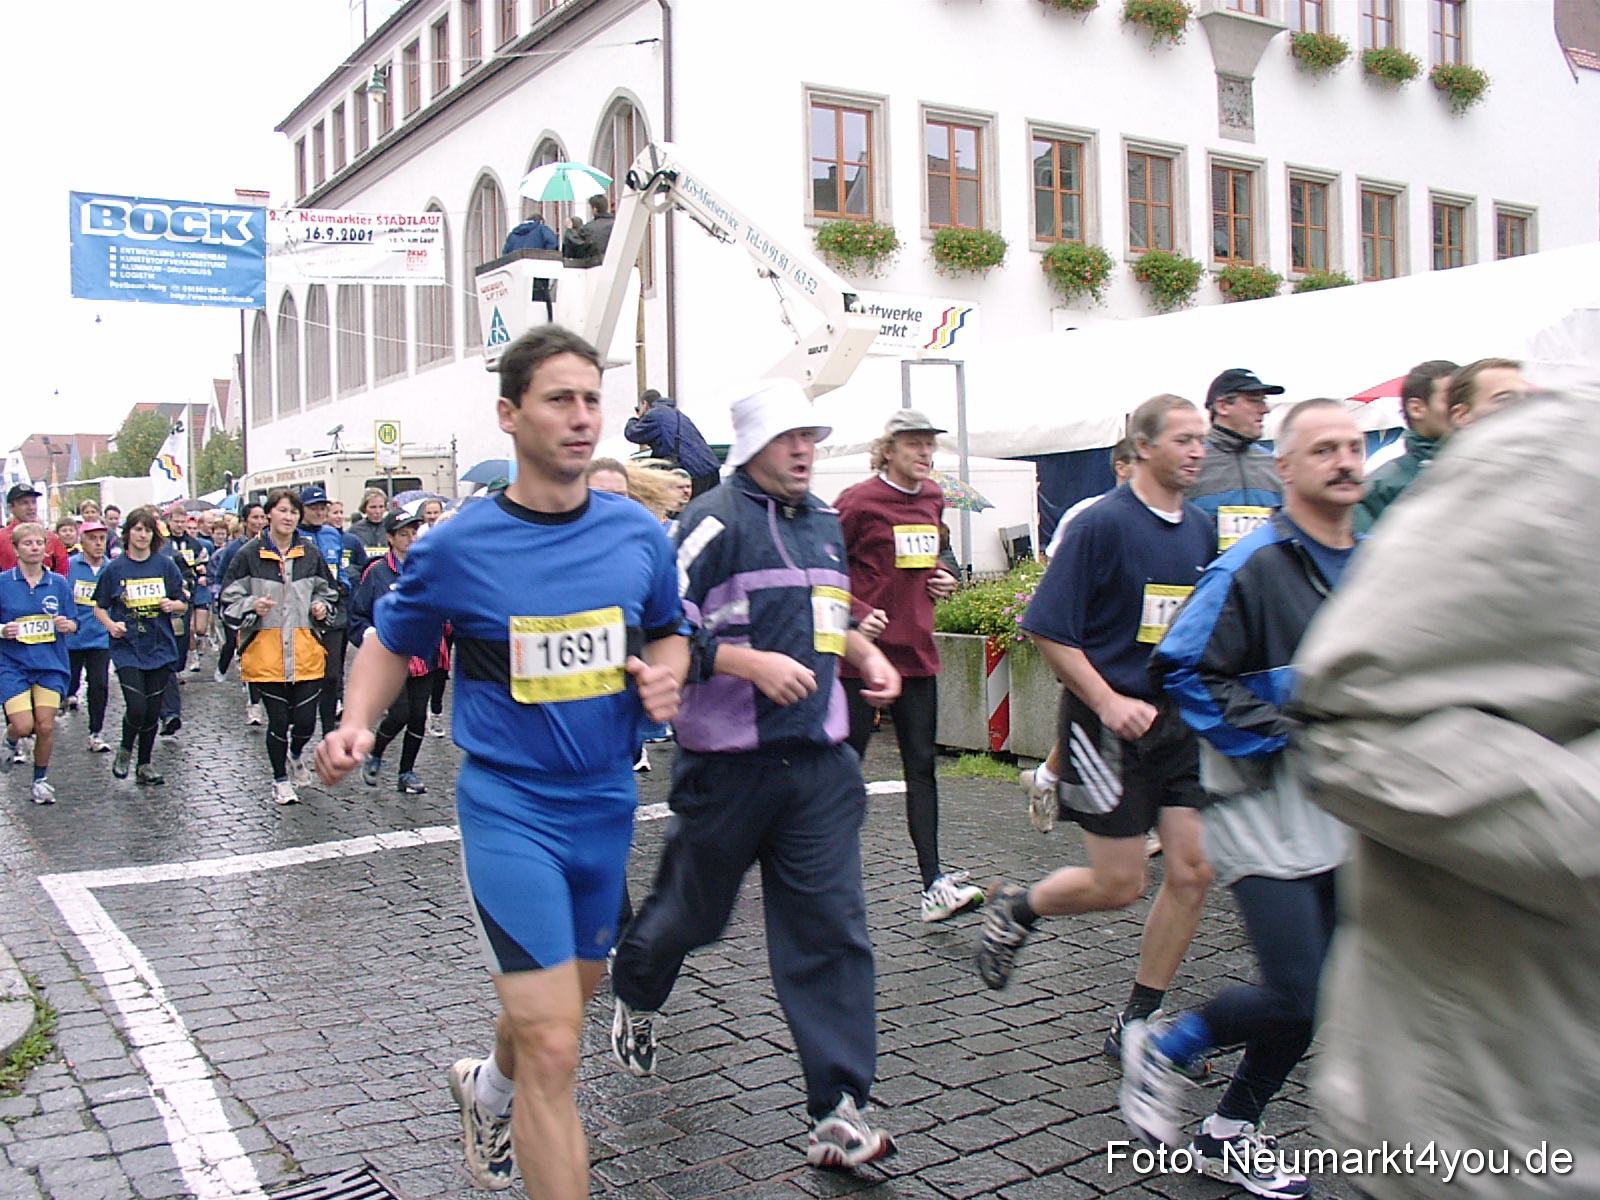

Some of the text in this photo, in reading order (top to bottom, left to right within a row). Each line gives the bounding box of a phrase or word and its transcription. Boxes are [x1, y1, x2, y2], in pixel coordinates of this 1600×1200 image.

[82, 199, 254, 247] BOCK
[299, 212, 372, 226] Neumarkter
[376, 215, 441, 226] STADTLAUF
[305, 227, 374, 242] 16.9.2001
[907, 535, 936, 553] 1137
[136, 584, 161, 596] 1751
[23, 620, 49, 634] 1750
[537, 628, 612, 670] 1691
